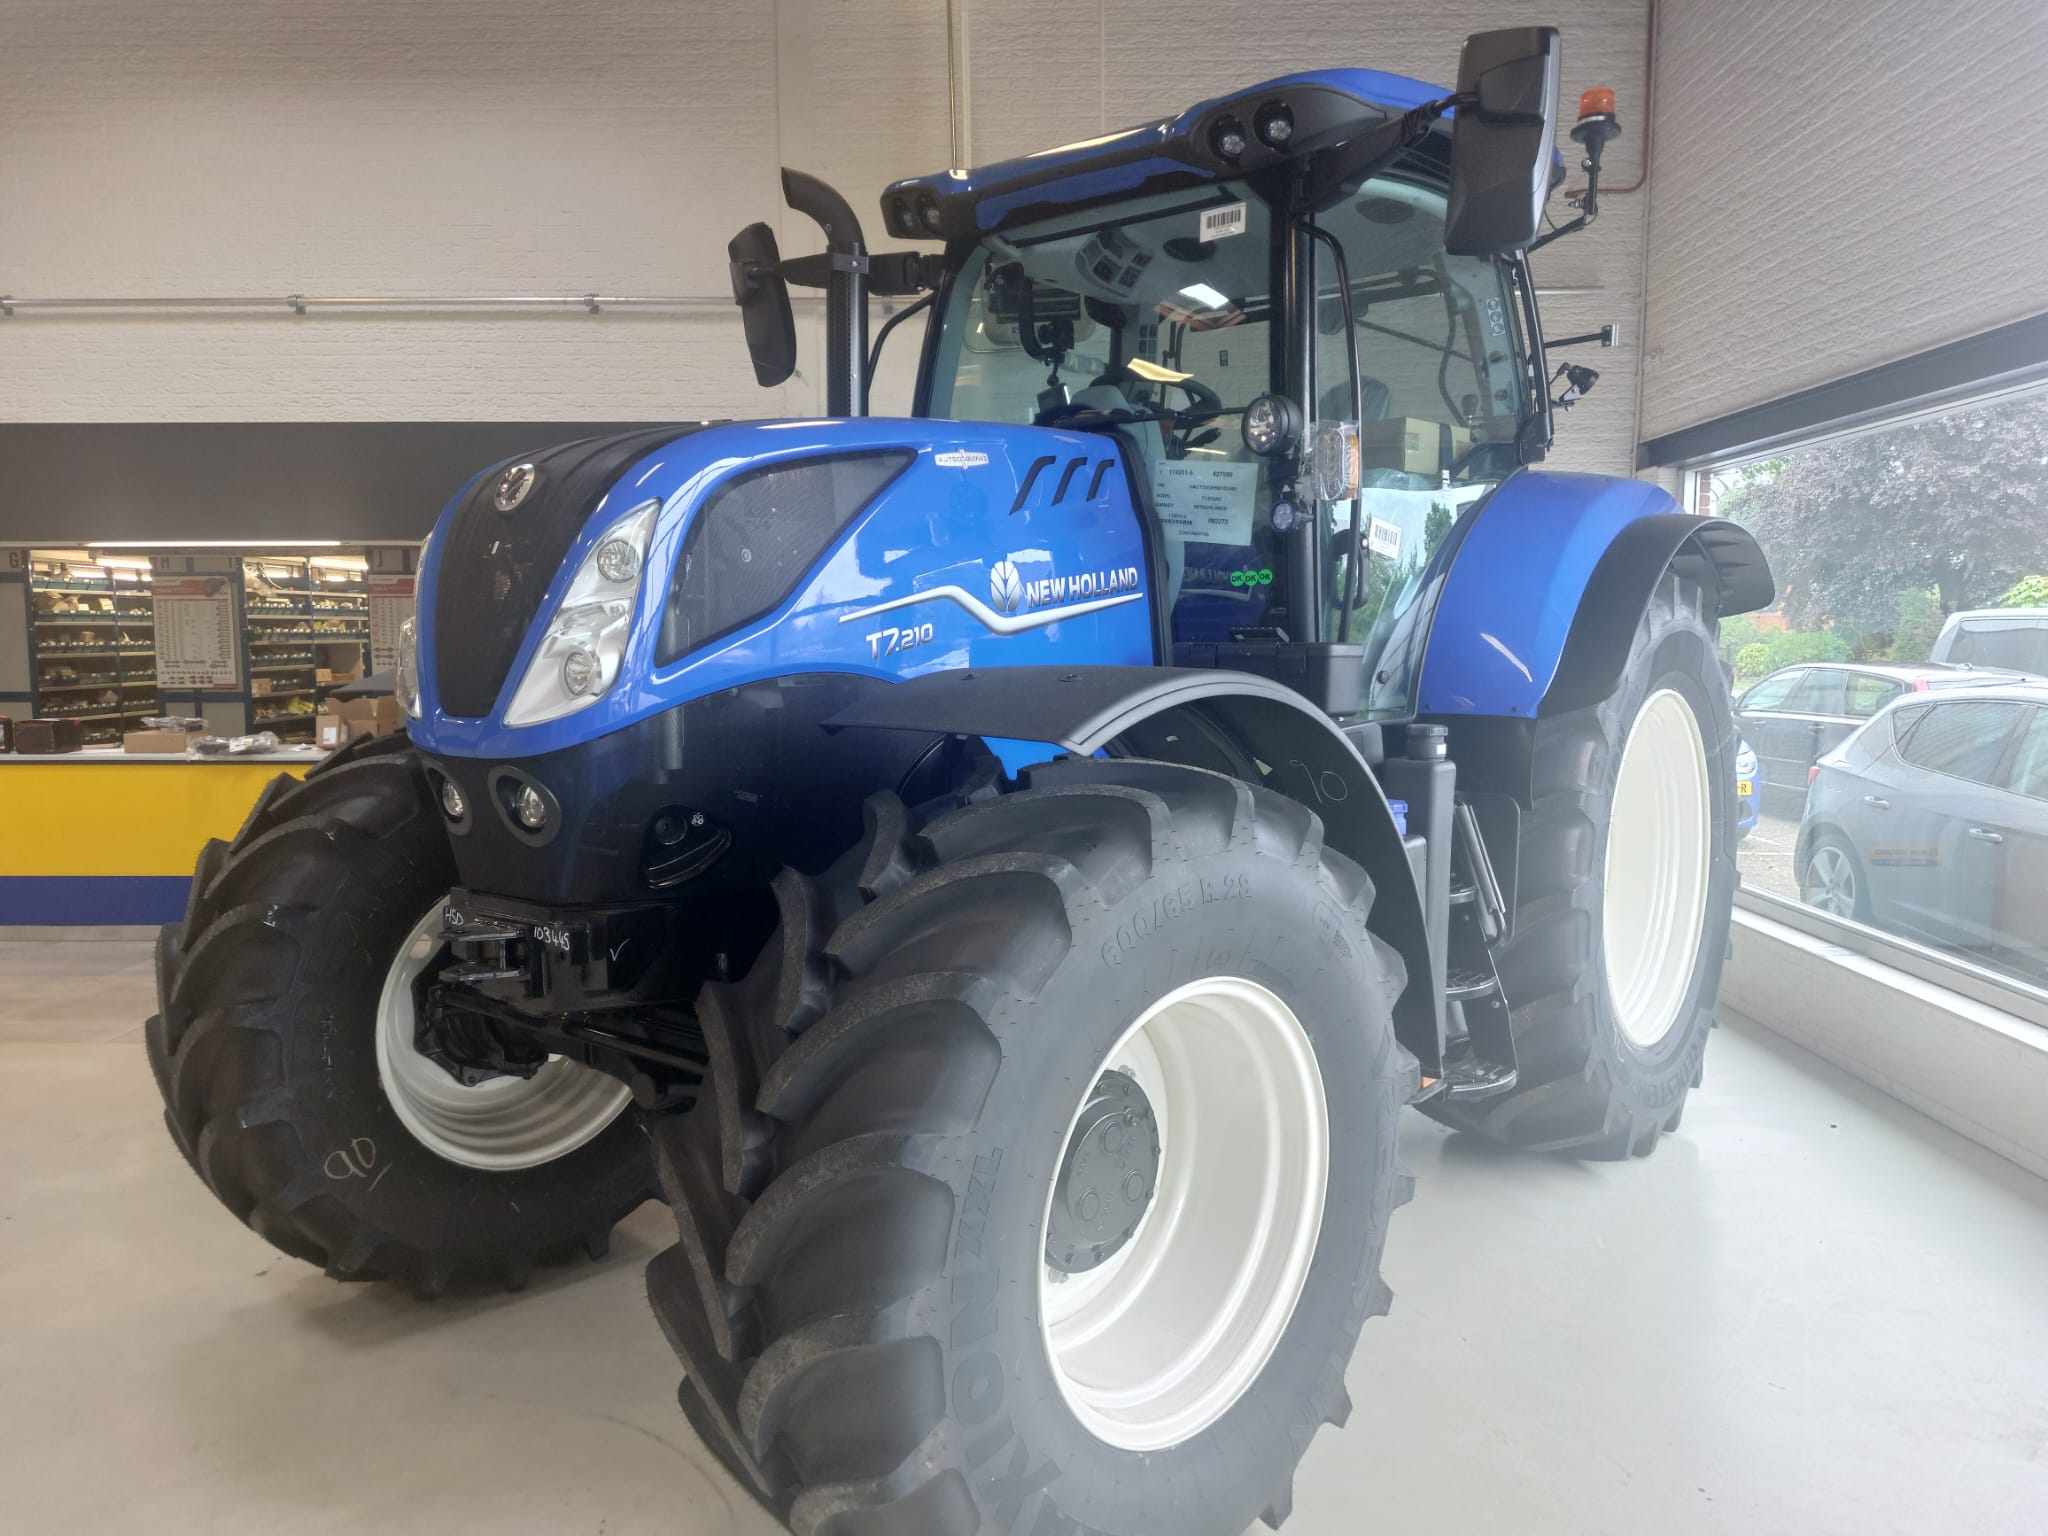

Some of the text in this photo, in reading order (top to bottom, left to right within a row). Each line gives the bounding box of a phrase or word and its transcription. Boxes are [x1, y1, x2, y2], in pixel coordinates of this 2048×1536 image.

[9, 551, 19, 569] G
[1026, 566, 1138, 609] NEW HOLLAND
[865, 623, 934, 661] T7.210
